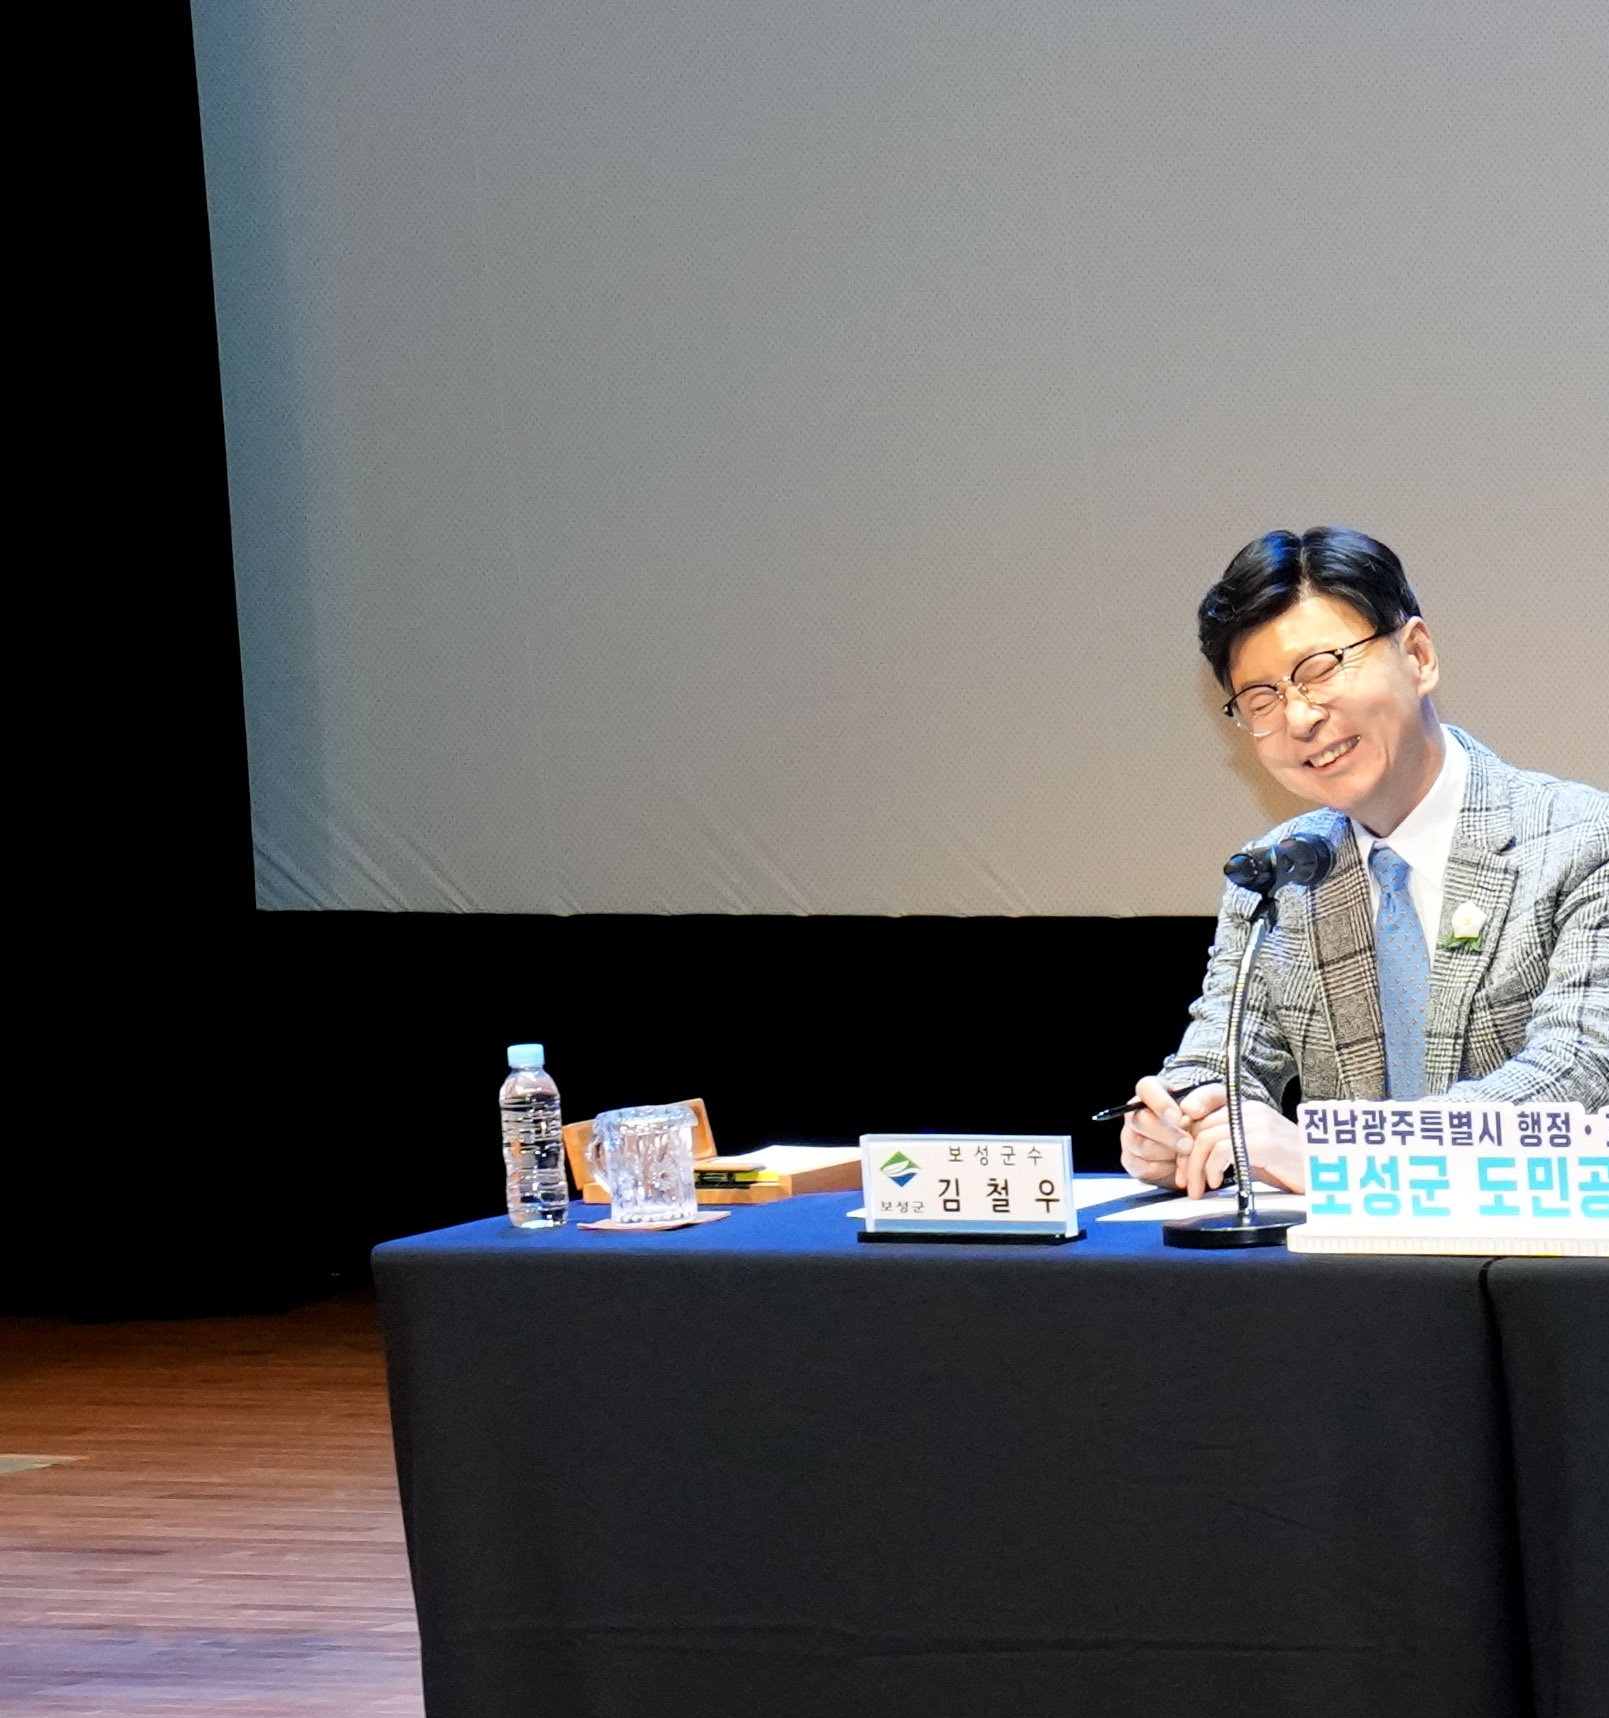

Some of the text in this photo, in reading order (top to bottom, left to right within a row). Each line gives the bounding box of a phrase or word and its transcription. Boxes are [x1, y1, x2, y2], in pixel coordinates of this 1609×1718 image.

[1304, 1109, 1502, 1147] 전남광주특별시
[1517, 1110, 1571, 1148] 행정
[1309, 1156, 1451, 1217] 보성군
[881, 1201, 925, 1213] 보성군
